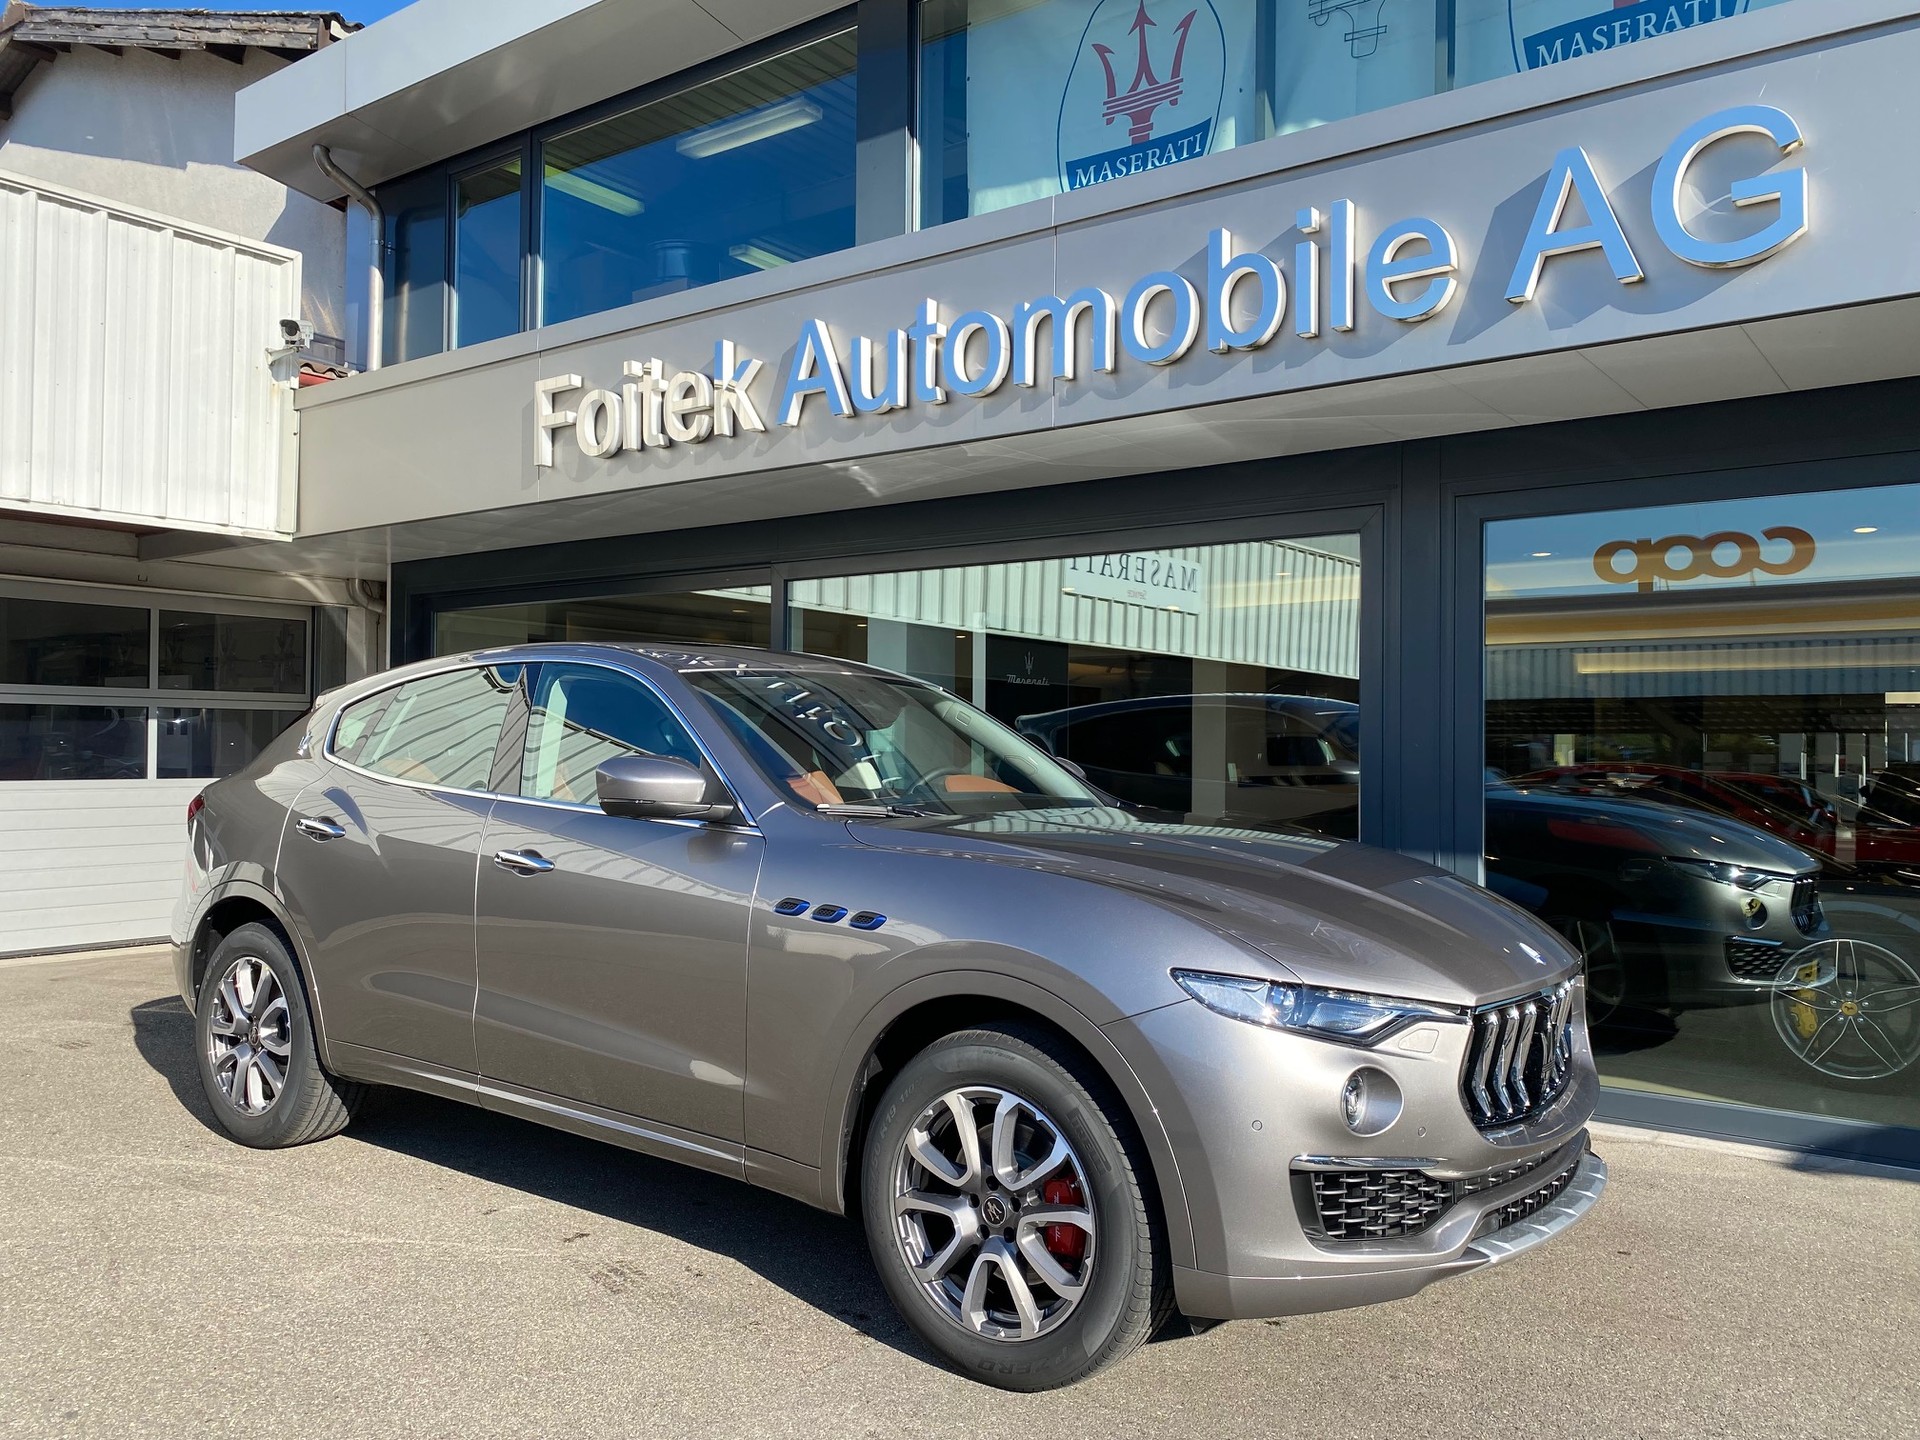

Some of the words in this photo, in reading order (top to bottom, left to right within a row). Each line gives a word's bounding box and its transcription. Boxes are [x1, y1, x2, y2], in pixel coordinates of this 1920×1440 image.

[1535, 0, 1726, 68] MASERATI
[1073, 132, 1203, 189] MASERATI
[534, 338, 766, 467] Foitek
[777, 198, 1459, 426] Automobile
[1504, 104, 1809, 304] AG
[1006, 674, 1050, 686] Maserati
